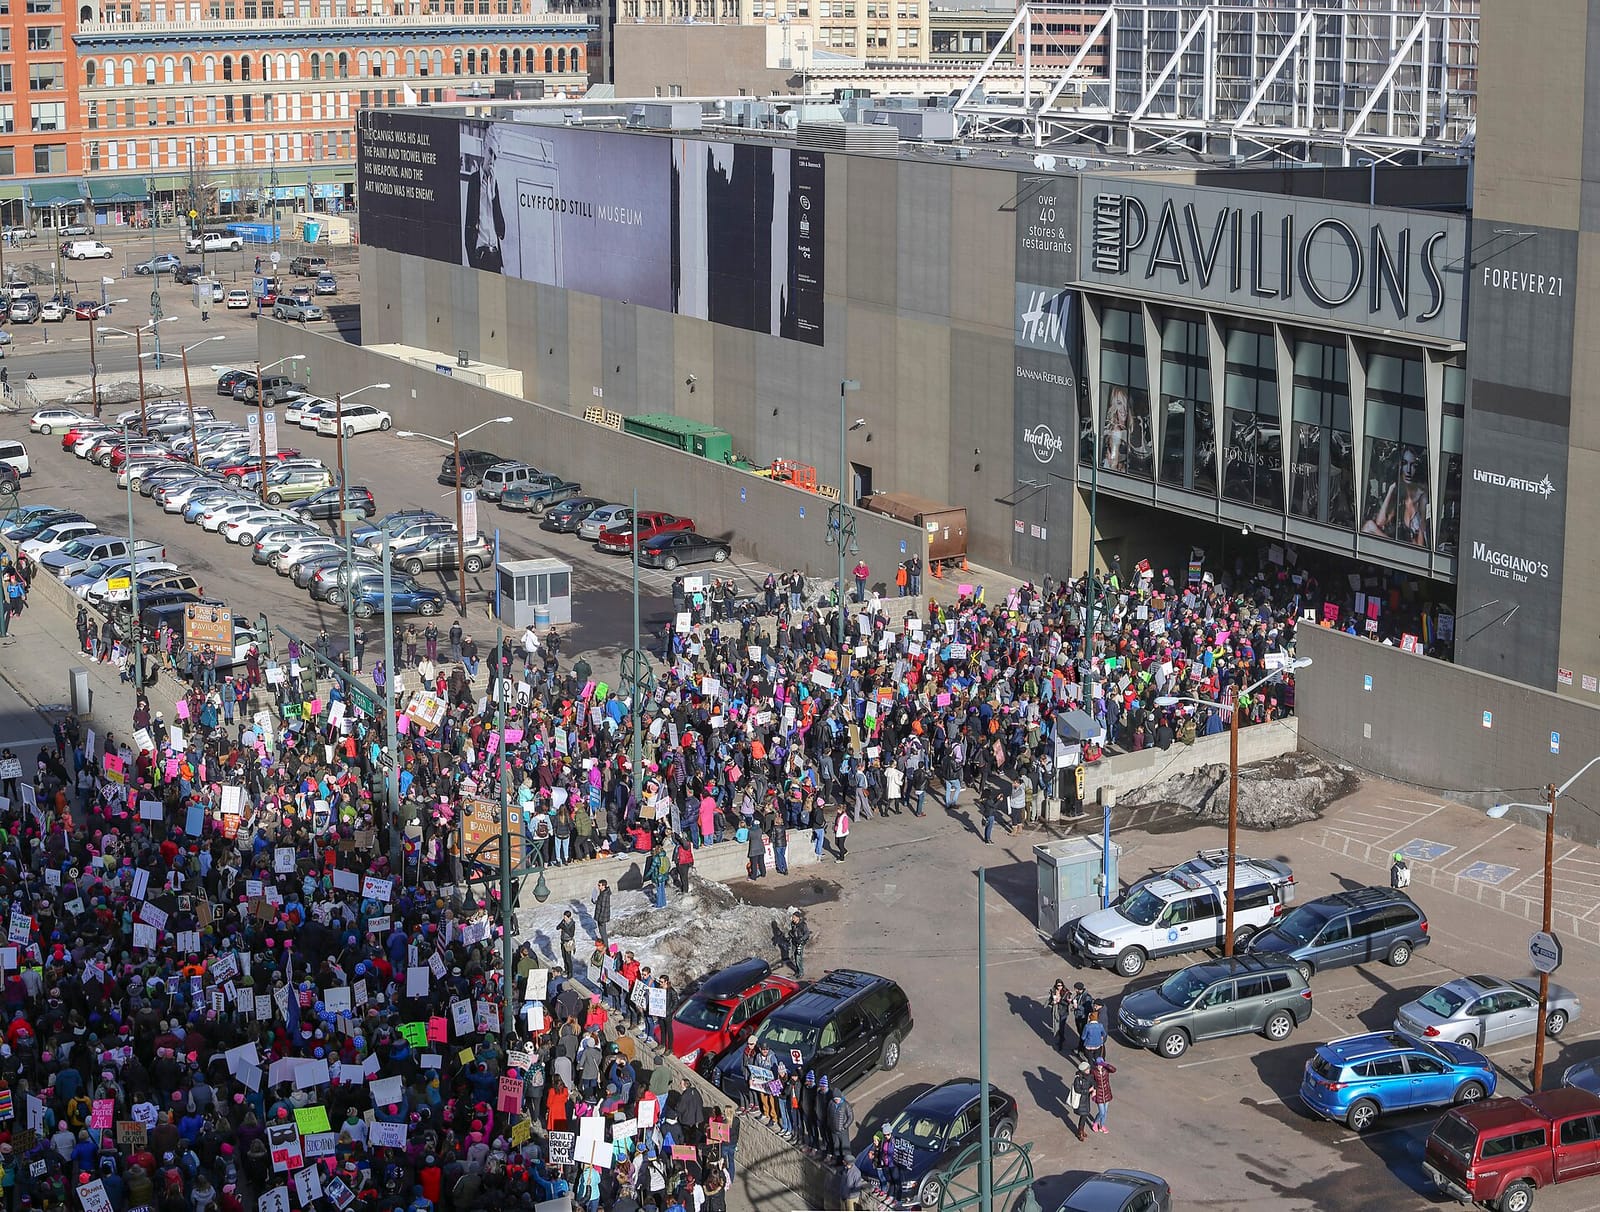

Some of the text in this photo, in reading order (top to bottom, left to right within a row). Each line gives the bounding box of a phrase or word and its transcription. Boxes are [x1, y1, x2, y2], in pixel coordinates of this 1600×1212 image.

[373, 129, 394, 142] CANVAS
[394, 131, 406, 143] WAS
[407, 132, 416, 144] HIS
[417, 134, 430, 146] ALLY.
[364, 146, 437, 165] THE PAINT AND TROWEL WERE
[364, 162, 372, 174] HIS
[400, 167, 412, 179] AND
[413, 168, 423, 180] THE
[365, 180, 435, 201] ART WORLD WAS HIS ENEMY.
[520, 193, 643, 226] CLYFFORD STILL MUSEUM
[1038, 195, 1056, 206] over
[1040, 208, 1056, 225] 40
[1029, 224, 1065, 239] stores &
[1095, 191, 1122, 272] DENVER
[1022, 238, 1072, 253] restaurants
[1121, 195, 1446, 321] PAVILIONS
[1484, 267, 1562, 296] FOREVER 21
[1021, 290, 1071, 349] H&M
[1024, 428, 1063, 452] Hard Rock
[1473, 469, 1546, 494] UNITED ARTISTS
[1473, 541, 1549, 578] MAGGIANO'S
[1490, 564, 1528, 583] LITTLE ITALY
[501, 1077, 522, 1088] SPEAK
[502, 1085, 519, 1093] OUT!
[94, 1120, 108, 1128] ALL
[550, 1132, 573, 1140] BUILD
[552, 1156, 573, 1164] WALLS
